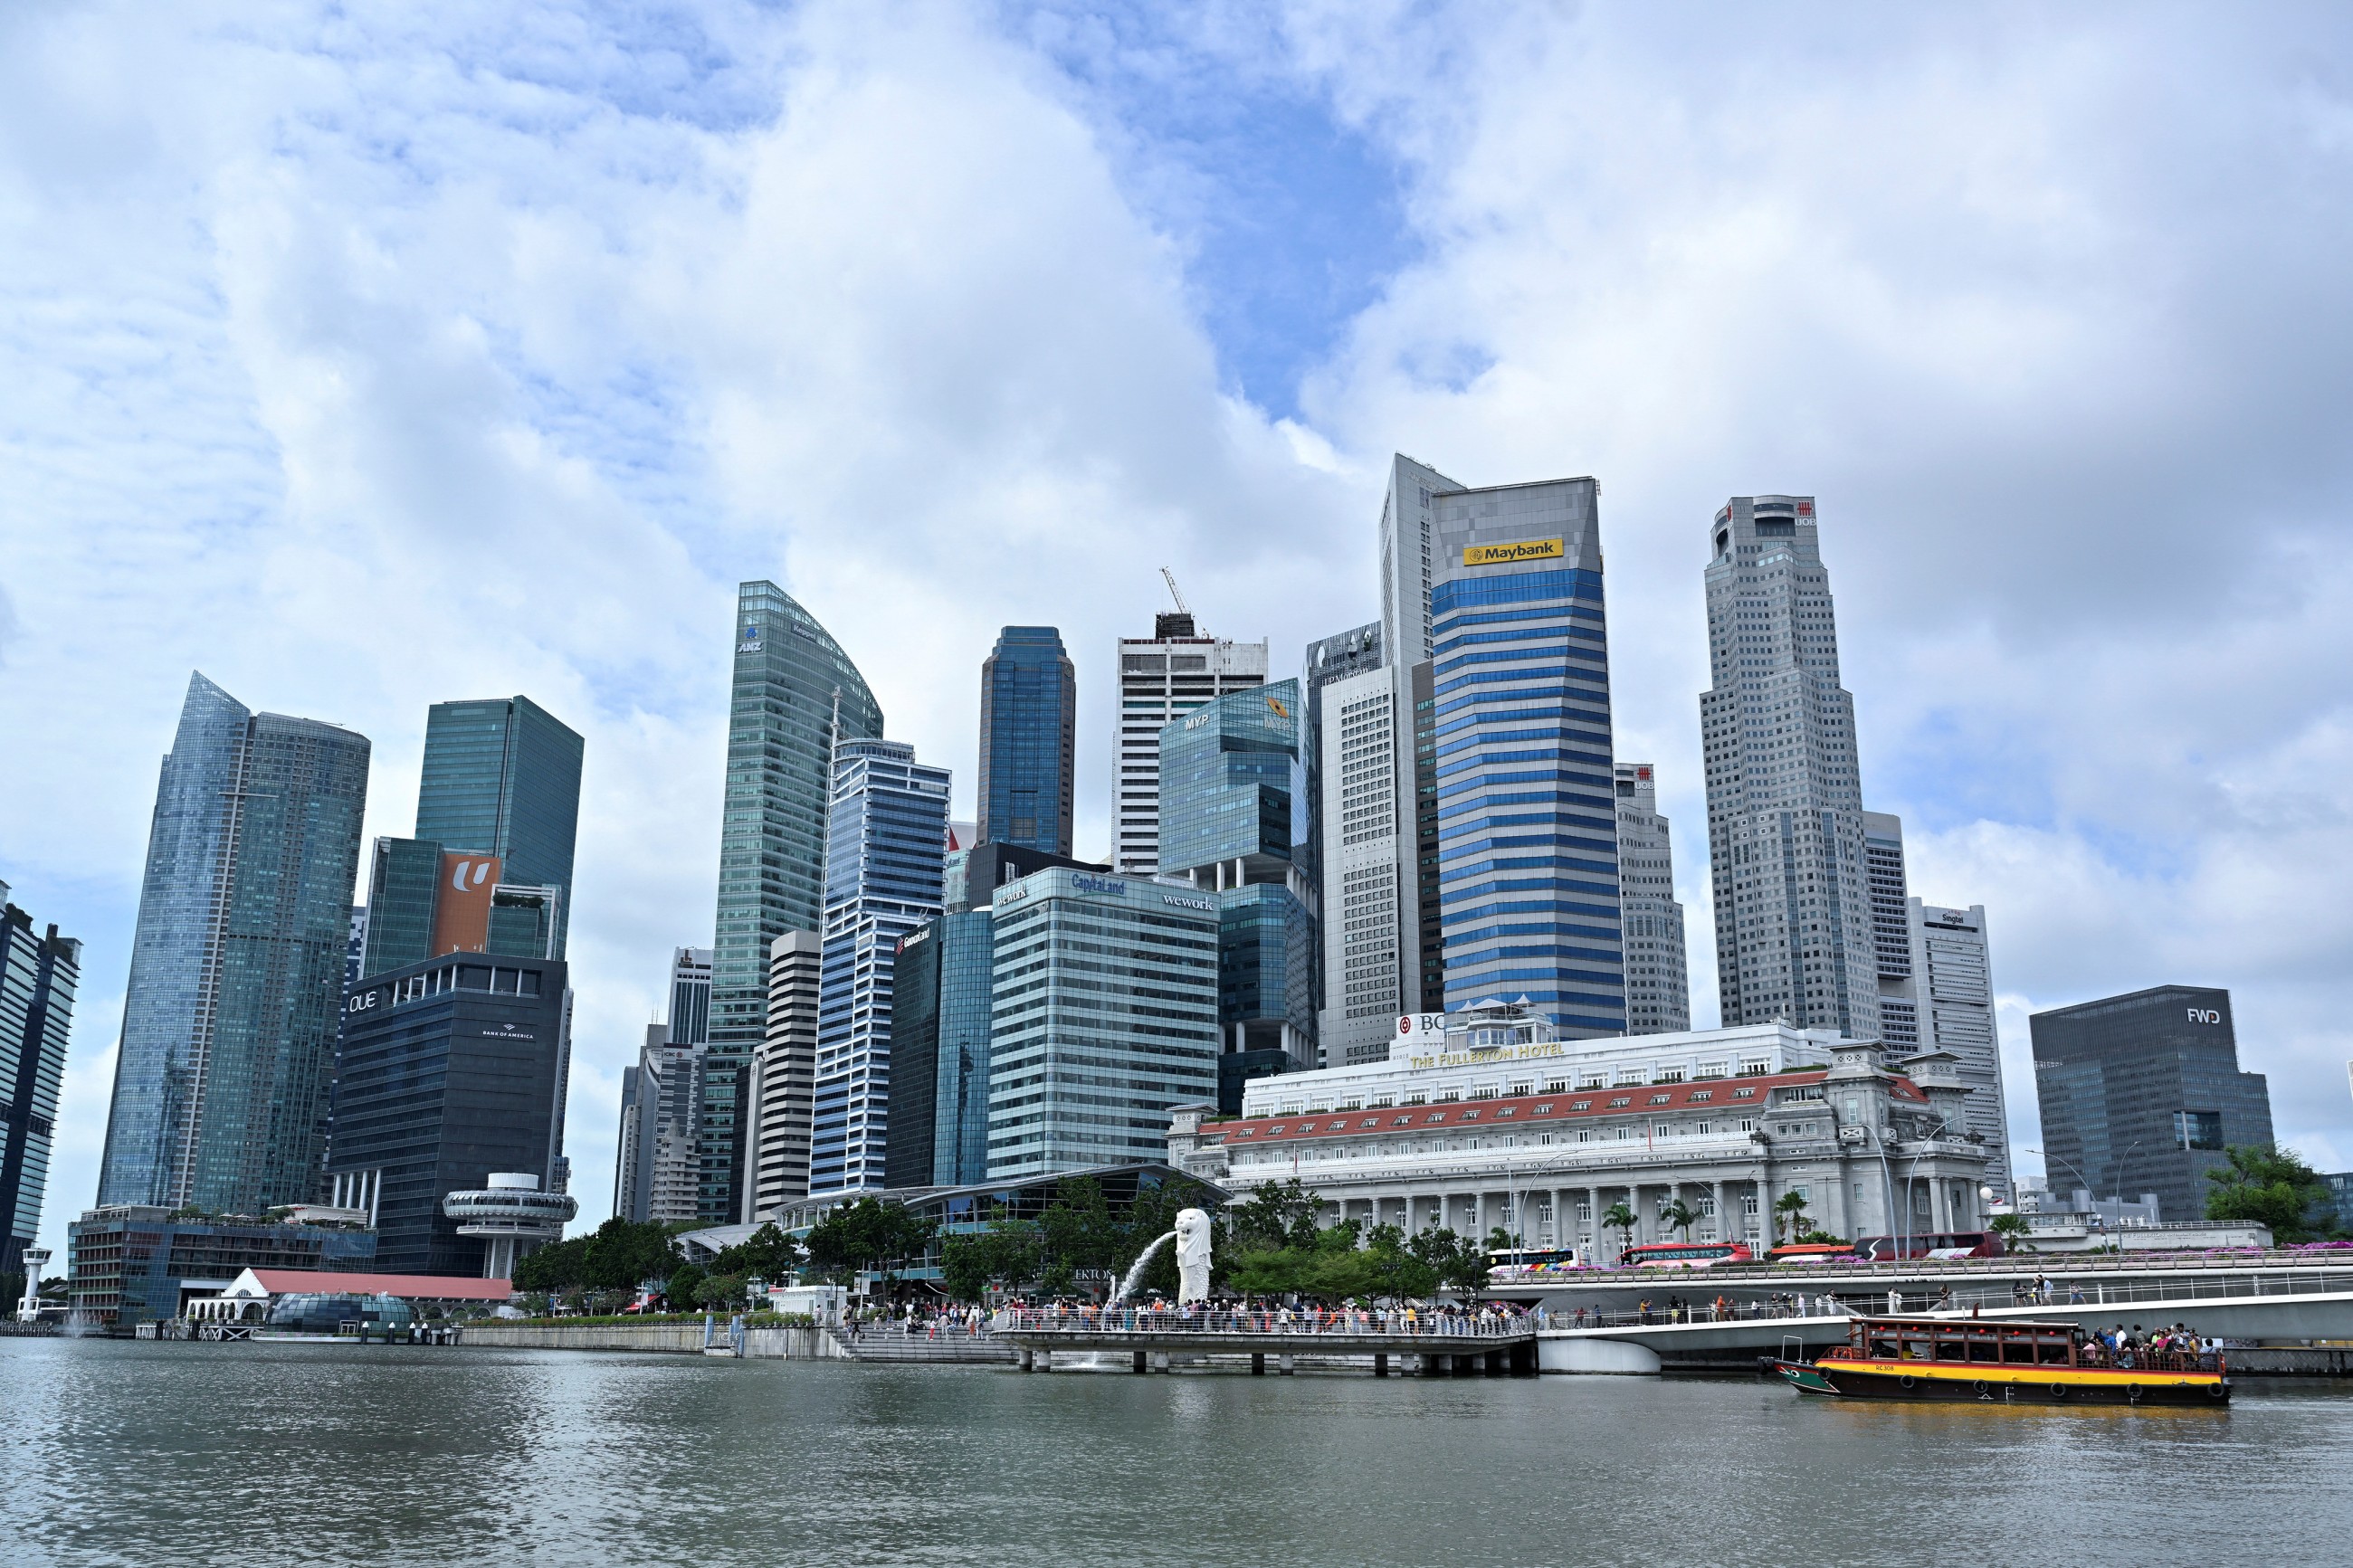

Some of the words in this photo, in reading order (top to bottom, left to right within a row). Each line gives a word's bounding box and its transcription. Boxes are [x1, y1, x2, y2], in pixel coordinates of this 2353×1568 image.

[1795, 518, 1816, 527] UOB
[1485, 542, 1554, 560] Maybank
[794, 624, 816, 640] Keppel
[738, 641, 763, 653] ANZ
[1186, 714, 1209, 731] MYP
[1264, 717, 1291, 731] MYP
[1635, 782, 1654, 790] UOB
[1072, 873, 1125, 896] CapitaLand
[996, 883, 1027, 908] wework
[1163, 895, 1215, 911] wework
[1942, 913, 1964, 925] Singtel
[349, 991, 377, 1012] OUE
[2186, 1008, 2221, 1024] FWD
[1410, 1056, 1434, 1069] THE
[1438, 1048, 1513, 1067] FULLERTON
[1518, 1042, 1565, 1059] HOTEL
